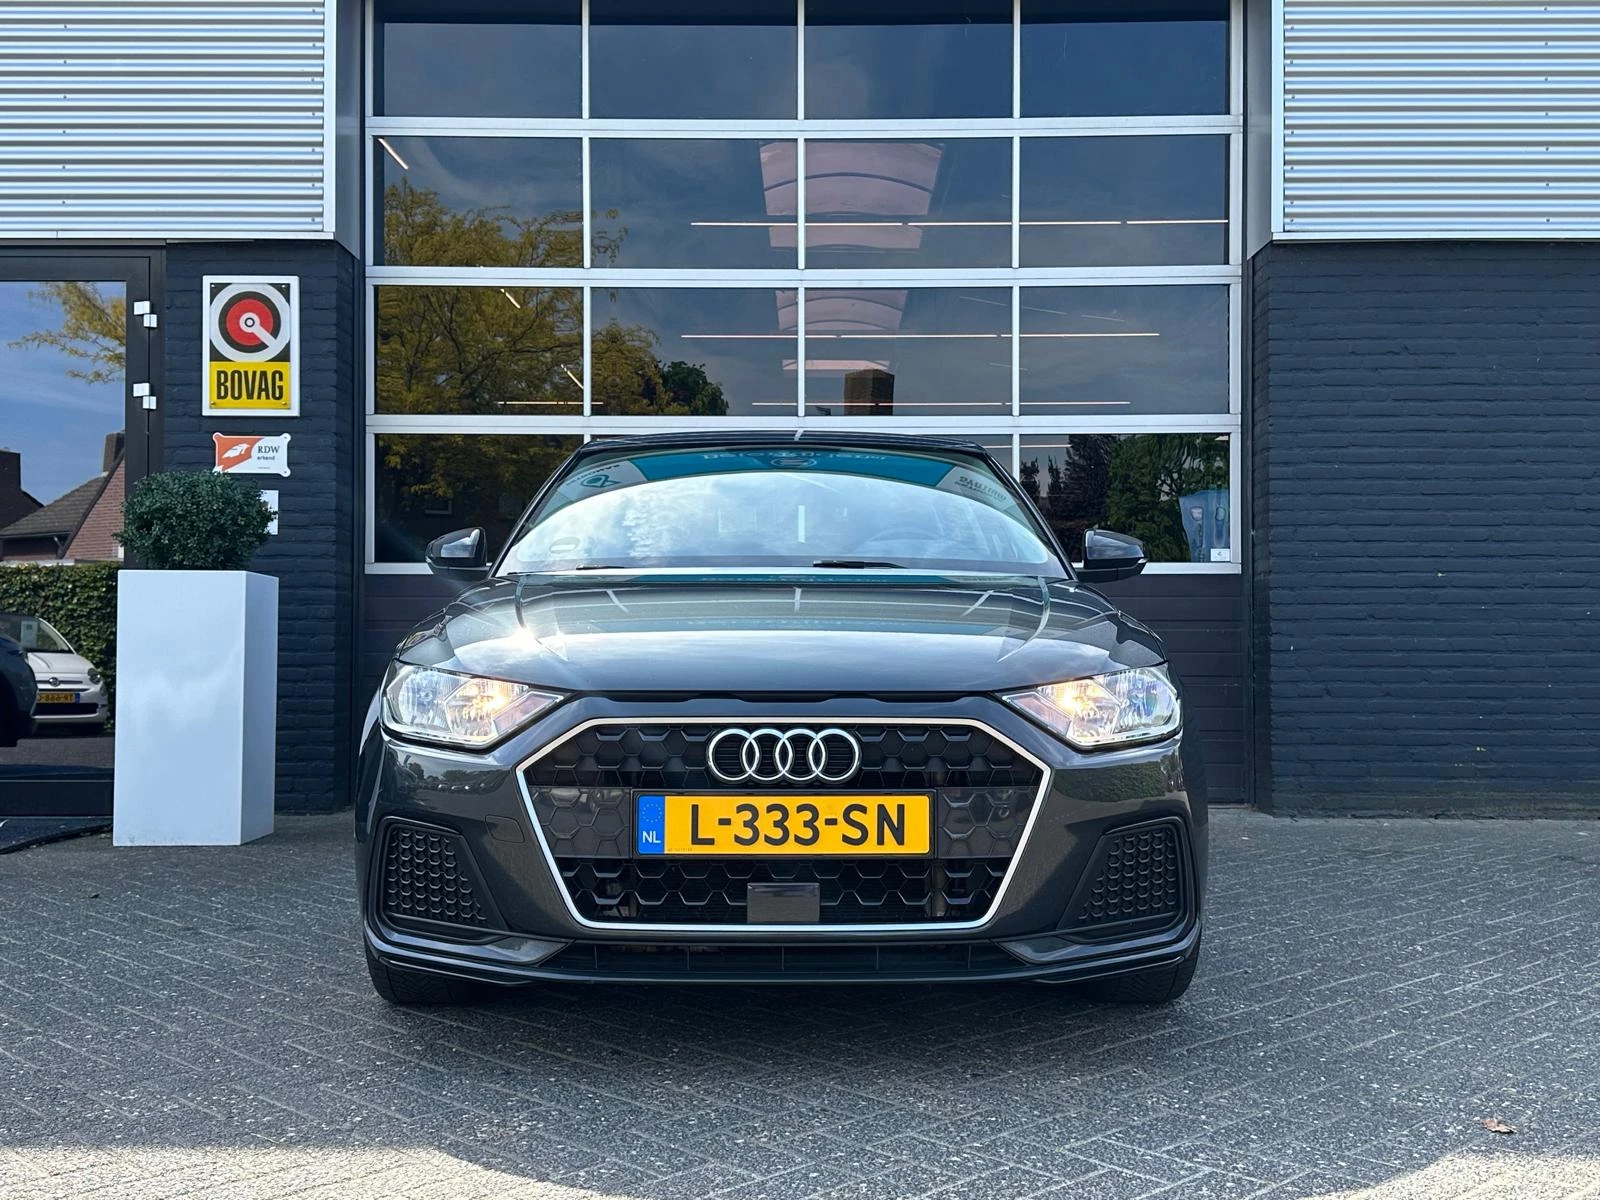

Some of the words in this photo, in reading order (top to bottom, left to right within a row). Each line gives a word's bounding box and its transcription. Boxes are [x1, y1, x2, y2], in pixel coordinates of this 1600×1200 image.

[216, 370, 284, 400] BOVAG
[257, 445, 280, 454] RDW
[690, 803, 905, 846] L-333-SN
[642, 831, 661, 844] NL
